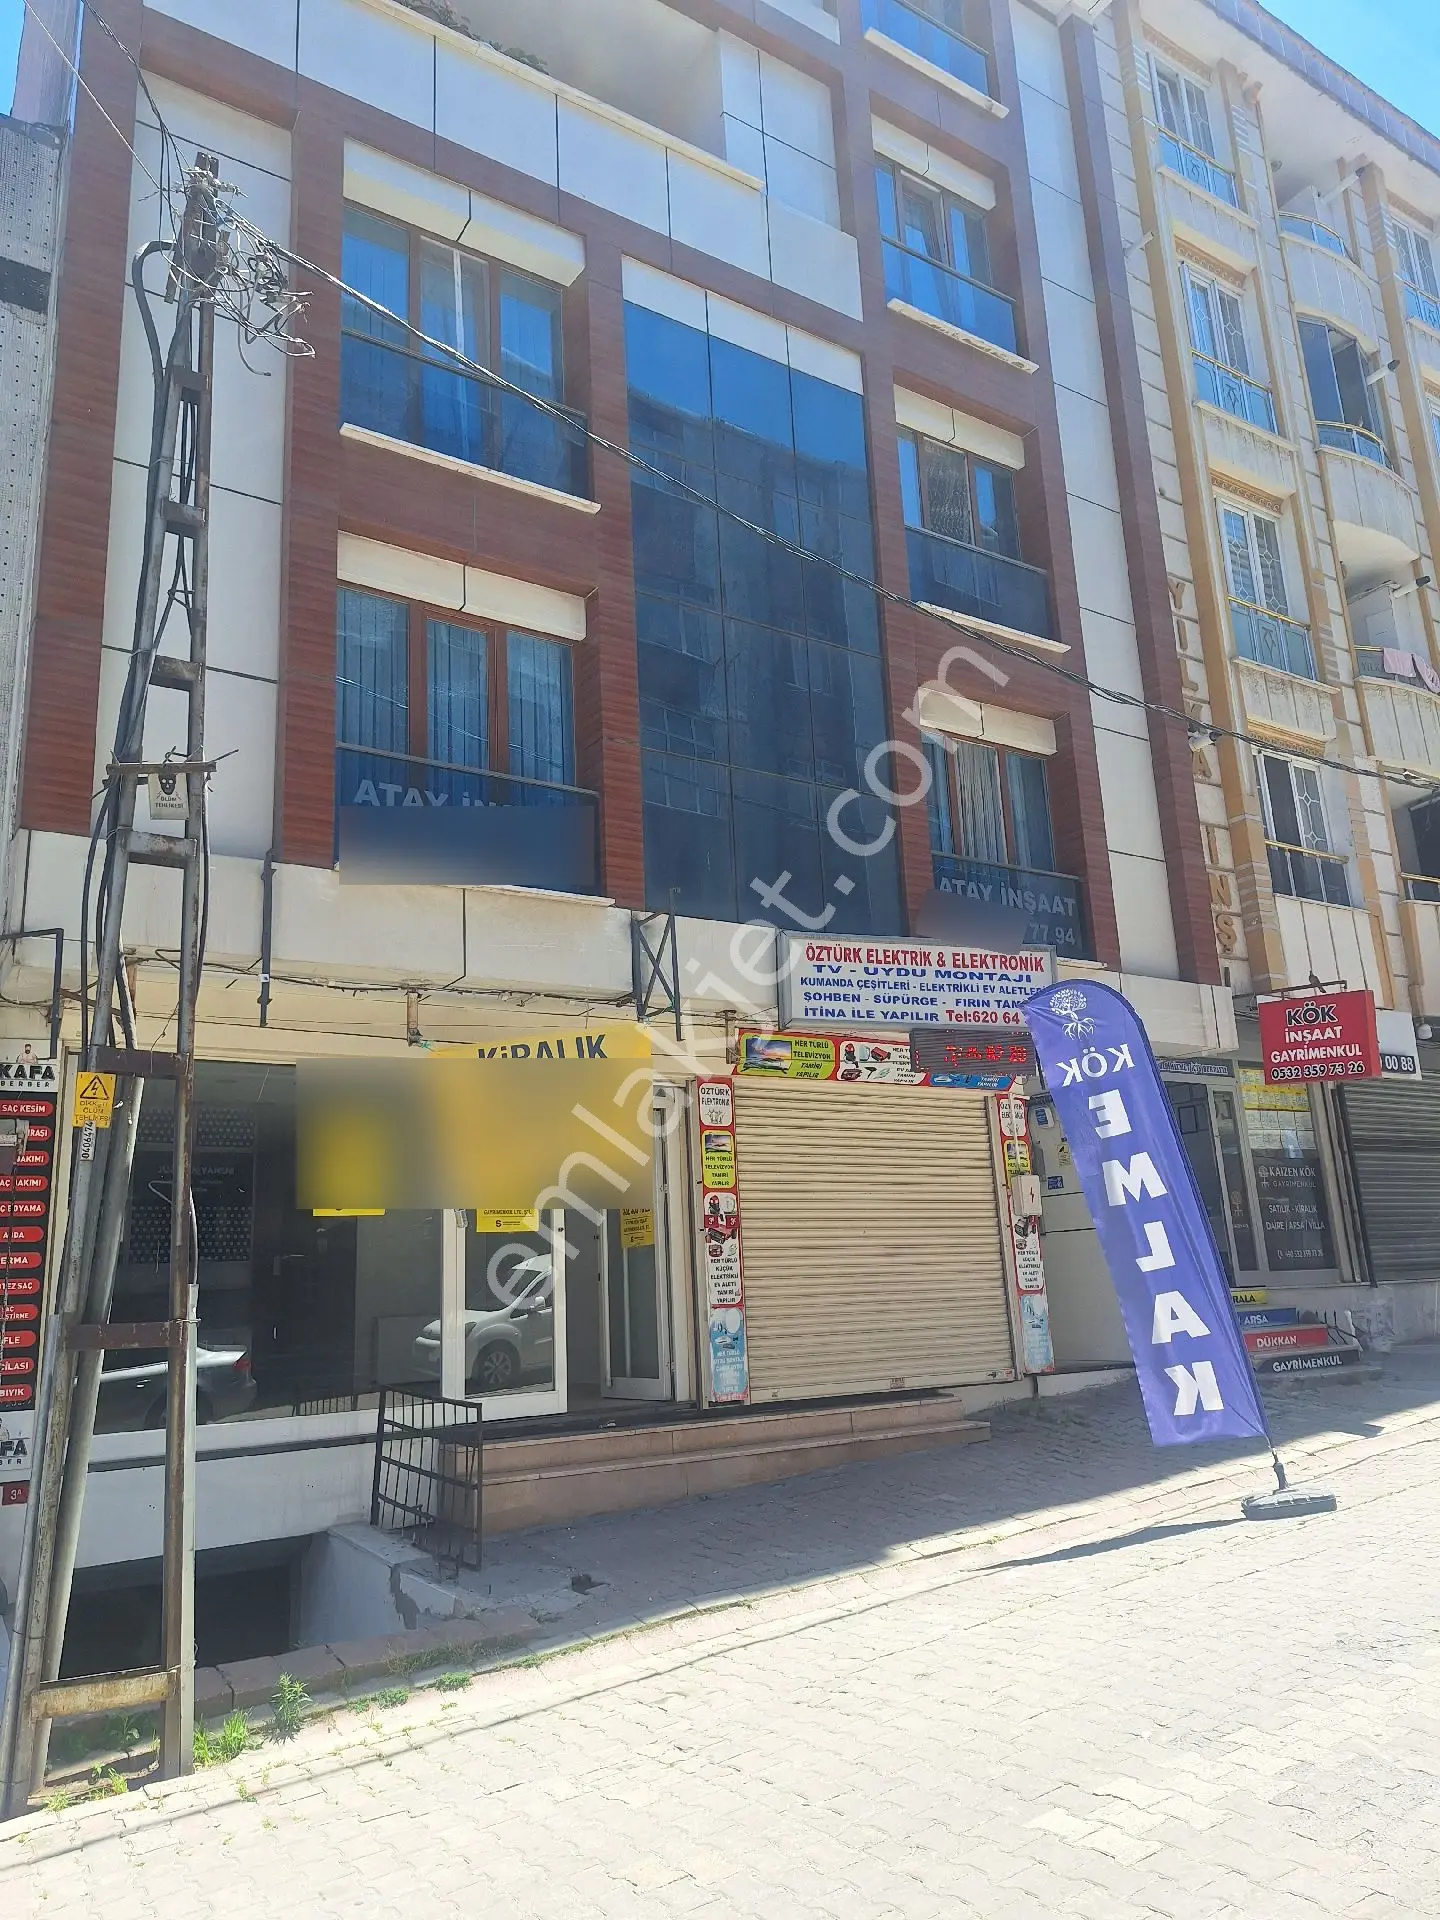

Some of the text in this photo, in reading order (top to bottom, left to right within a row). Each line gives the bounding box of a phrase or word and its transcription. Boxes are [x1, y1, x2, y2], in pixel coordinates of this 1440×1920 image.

[939, 876, 1076, 917] ATAY İNŞAAT
[1055, 927, 1076, 945] 94
[805, 942, 1045, 972] ÖZTÜRK ELEKTRİK & ELEKTRONİK
[813, 964, 843, 974] TV
[863, 966, 927, 977] UYDU
[934, 969, 1032, 983] MONTAJI
[800, 976, 854, 988] KUMANDA
[856, 978, 910, 991] ÇEŞİTLERİ
[919, 982, 980, 993] ELEKTRİKLİ
[983, 984, 996, 994] EV
[803, 991, 861, 1003] ŞOHBEN
[873, 993, 938, 1006] SÜPÜRGE
[955, 998, 991, 1008] FIRIN
[804, 1005, 1021, 1025] İTİNA İLE YAPILIR Tel:620 64
[1286, 1001, 1338, 1027] KÖK
[1285, 1026, 1343, 1045] İNŞAAT
[792, 1051, 831, 1060] TELEVİZYON
[1270, 1044, 1363, 1063] GAYRİMENKUL
[0, 1064, 56, 1081] KAFA
[1271, 1067, 1302, 1081] 0532
[1304, 1065, 1327, 1078] 359
[1329, 1063, 1345, 1076] 73
[1348, 1061, 1366, 1075] 26
[1384, 1055, 1415, 1072] 00 88
[2, 1103, 46, 1113] SAÇ KESİM
[81, 1121, 94, 1160] 0406474
[1300, 1165, 1316, 1177] KÖK
[1243, 1315, 1269, 1325] ARSA
[1256, 1335, 1297, 1348] DÜKKAN
[1272, 1355, 1343, 1373] GAYRİMENKUL
